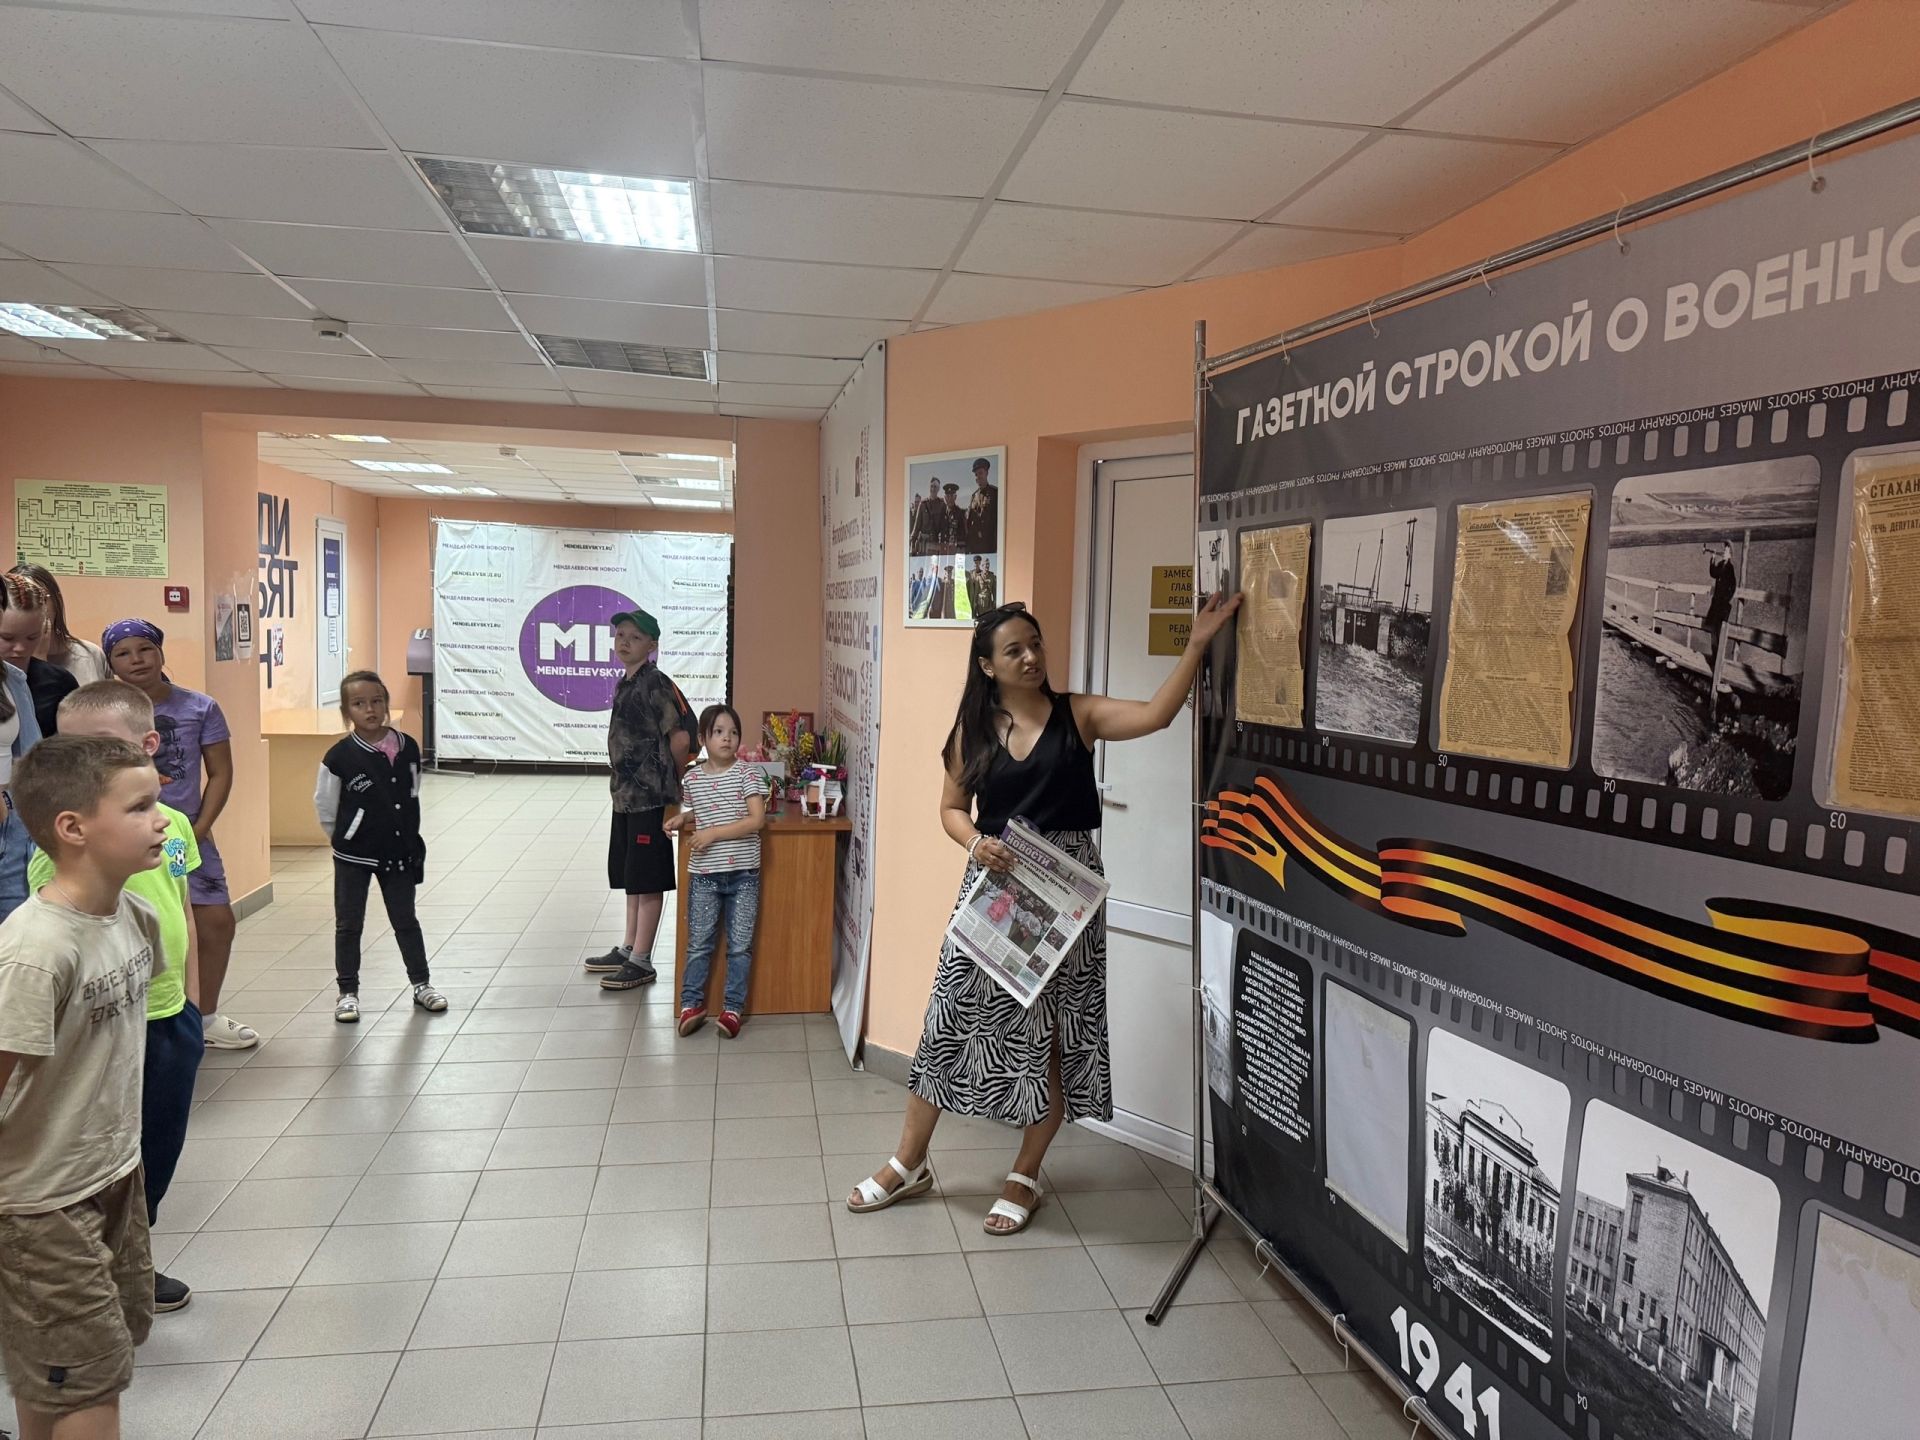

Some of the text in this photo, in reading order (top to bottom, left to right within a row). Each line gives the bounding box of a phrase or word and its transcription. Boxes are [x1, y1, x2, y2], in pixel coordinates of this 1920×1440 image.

[1236, 215, 1920, 445] ГАЗЕТНОЙ СТРОКОЙ О ВОЕННО
[1767, 388, 1815, 409] SHOOTS
[1822, 378, 1874, 400] PHOTOS
[1720, 398, 1761, 417] IMAGES
[1598, 419, 1635, 438] PHOTOS
[1639, 406, 1714, 431] PHOTOGRAPHY
[1526, 433, 1556, 448] IMAGES
[1560, 426, 1594, 443] SHOOTS
[1439, 448, 1465, 463] PHOTOS
[1467, 438, 1522, 458] PHOTOGRAPHY
[1383, 459, 1406, 472] IMAGES
[1409, 453, 1436, 468] SHOOTS
[1316, 470, 1340, 484] PHOTOS
[1341, 463, 1381, 480] PHOTOGRAPHY
[1870, 478, 1920, 498] СТАХАН
[1889, 519, 1920, 533] ДЕПУТАТ
[825, 610, 870, 651] МЕНДЕЛЕЕВСКИЕ
[1169, 624, 1192, 634] РЕДА
[832, 661, 857, 706] НОВОСТИ
[1829, 811, 1846, 829] 03
[1006, 834, 1051, 867] НОВОСТИ
[1312, 924, 1330, 941] PHOTOS
[1332, 934, 1367, 958] PHOTOGRAPHY
[1370, 950, 1390, 968] IMAGES
[1392, 960, 1417, 979] SHOOTS
[1420, 971, 1447, 992] PHOTOS
[1448, 982, 1501, 1013] PHOTOGRAPHY
[1505, 1005, 1533, 1026] IMAGES
[1536, 1018, 1567, 1041] SHOOTS
[1570, 1032, 1604, 1057] PHOTOS
[1607, 1048, 1678, 1088] PHOTOGRAPHY
[1683, 1078, 1723, 1106] IMAGES
[1728, 1096, 1775, 1128] SHOOTS
[1780, 1116, 1830, 1150] PHOTOS
[1390, 1305, 1500, 1440] 1941
